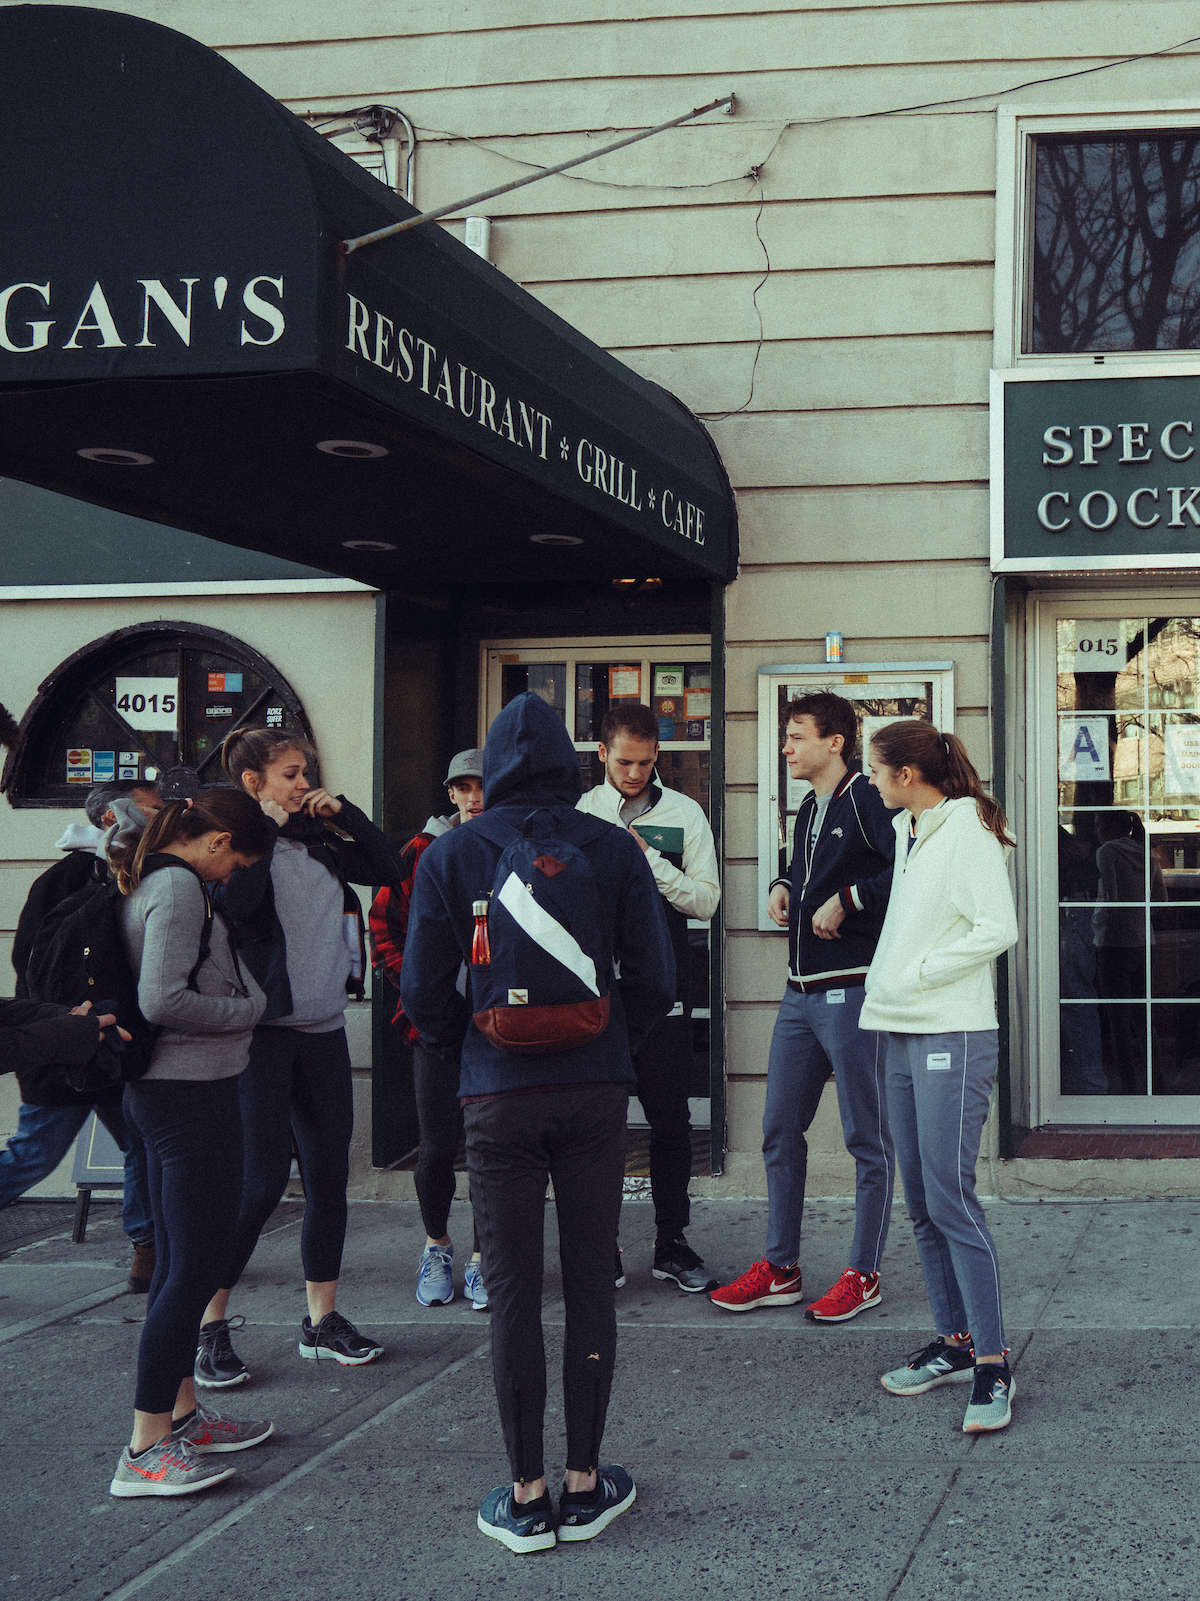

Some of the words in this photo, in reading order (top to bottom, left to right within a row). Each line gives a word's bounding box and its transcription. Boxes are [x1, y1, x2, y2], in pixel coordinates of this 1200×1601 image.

[346, 292, 554, 461] RESTAURANT
[576, 438, 642, 511] GRILL
[660, 488, 706, 547] CAFE
[117, 693, 176, 714] 4015
[1067, 725, 1101, 763] A
